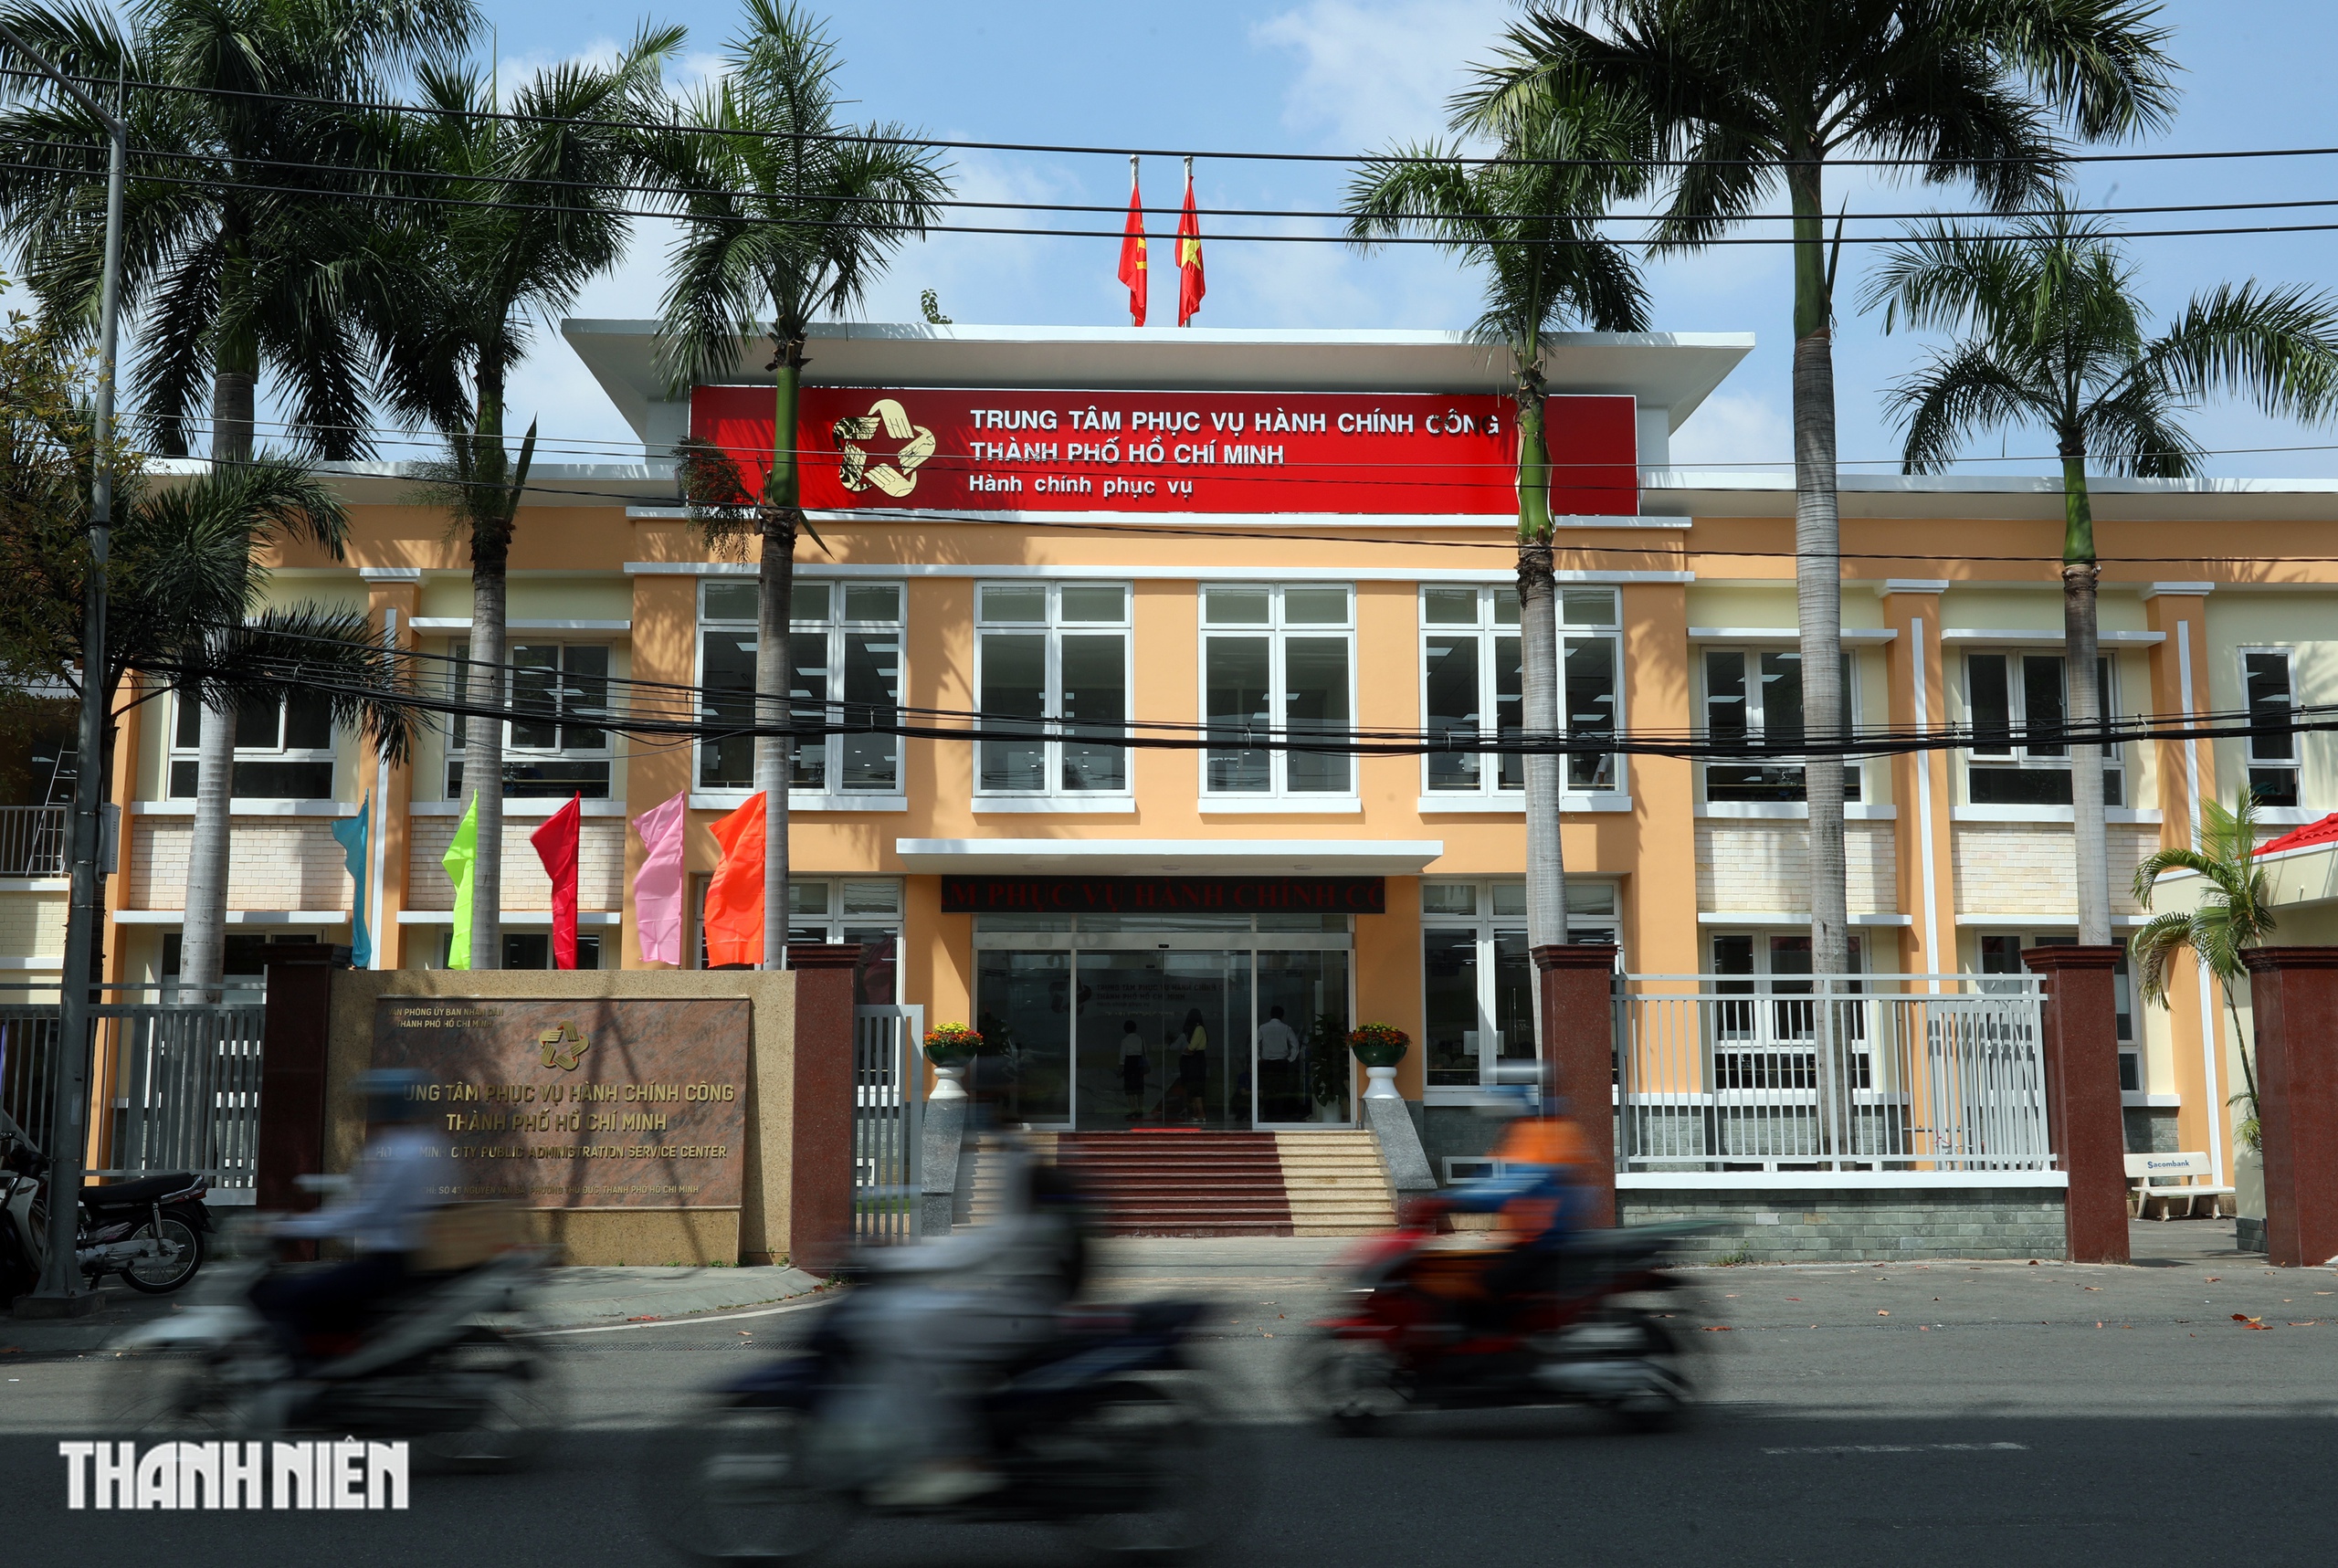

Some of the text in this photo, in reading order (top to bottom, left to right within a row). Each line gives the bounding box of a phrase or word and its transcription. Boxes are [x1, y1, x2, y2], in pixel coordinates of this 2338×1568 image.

[970, 405, 1500, 437] TRUNG TÂM PHỤC VỤ HÀNH CHÍNH CÔNG
[969, 435, 1284, 464] THÀNH PHỐ HỒ CHÍ MINH
[969, 474, 1194, 499] Hành chính phục vụ
[942, 883, 977, 907] M
[988, 883, 1074, 913] PHỤC
[1082, 883, 1124, 913] VỤ
[1135, 878, 1224, 907] HÀNH
[1234, 878, 1336, 907] CHÍNH
[446, 1007, 461, 1016] BAN
[403, 1080, 735, 1107] UNG TÂM PHỤC VỤ HÀNH CHÍNH CÔNG
[446, 1108, 668, 1131] THÀNH PHỐ HỒ CHÍ MINH
[450, 1146, 477, 1159] CITY
[480, 1146, 524, 1159] PUBLIC
[528, 1145, 626, 1159] ADMINISTRATION
[628, 1145, 677, 1159] SERVICE
[680, 1145, 728, 1159] CENTER
[2147, 1160, 2190, 1169] Sacombank
[679, 1185, 700, 1194] MINH
